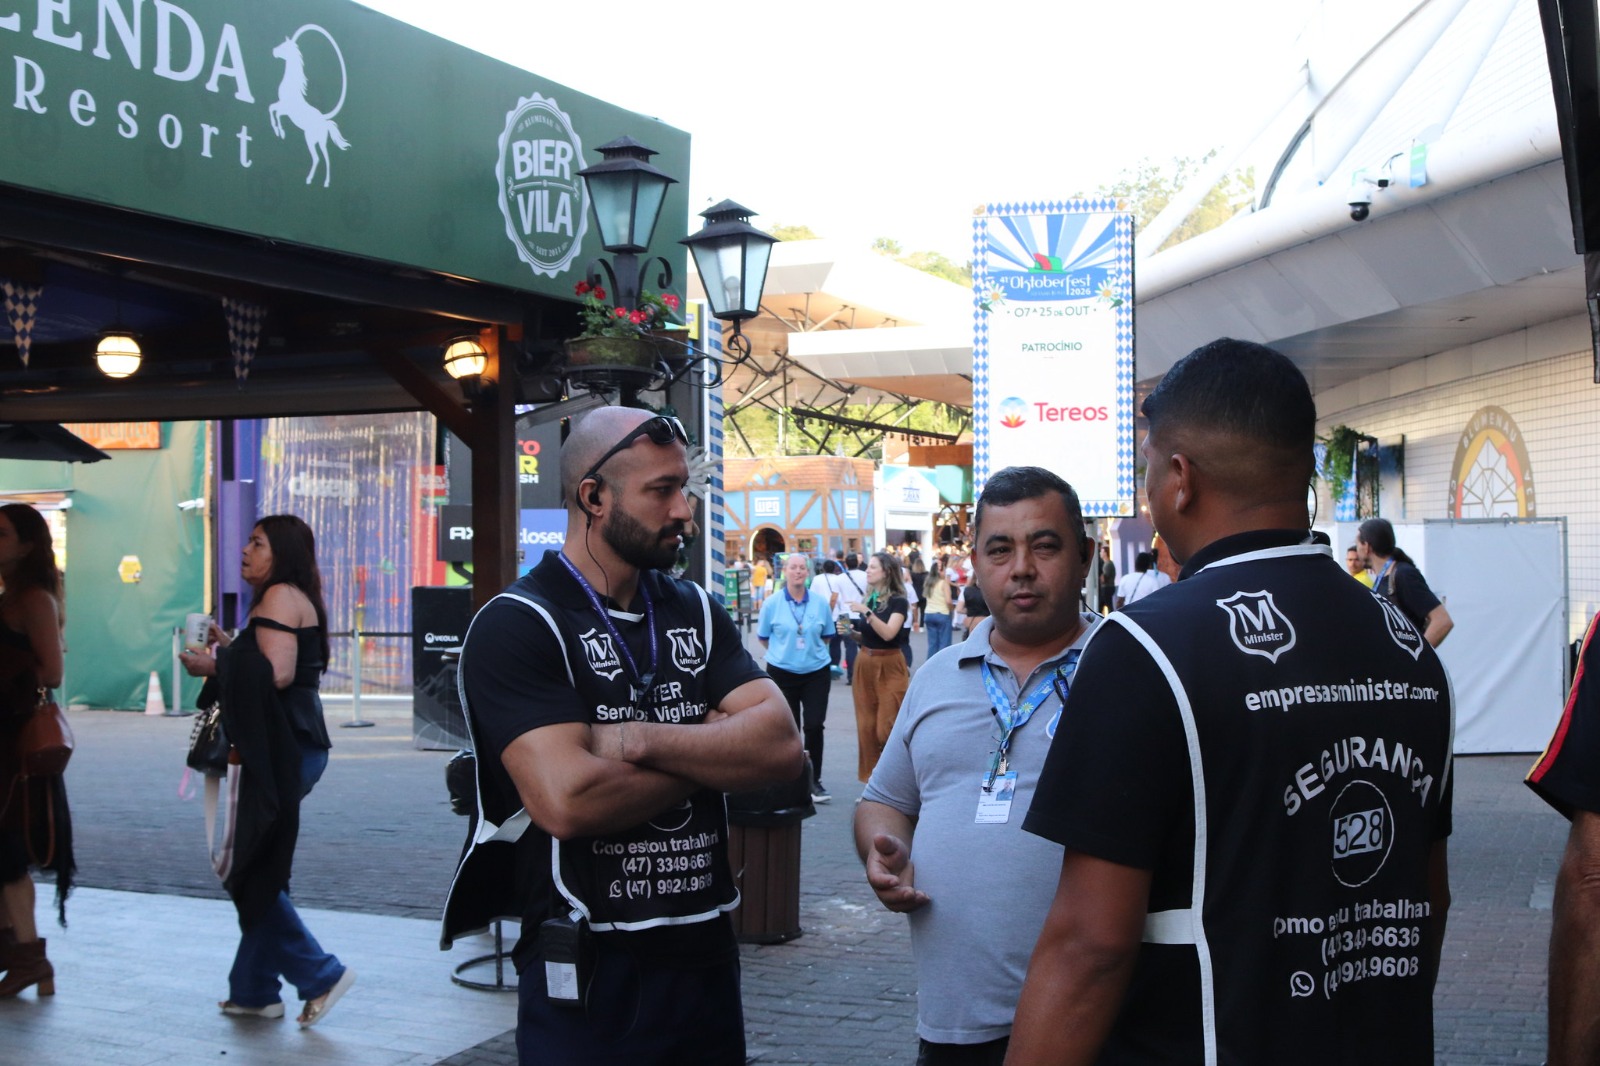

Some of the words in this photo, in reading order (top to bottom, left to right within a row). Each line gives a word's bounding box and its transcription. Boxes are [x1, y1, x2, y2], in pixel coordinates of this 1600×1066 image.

[0, 0, 255, 103] ENDA
[13, 55, 253, 168] Resort
[512, 139, 573, 180] BIER
[517, 189, 574, 237] VILA
[1010, 274, 1091, 296] Oktoberfest
[1070, 288, 1091, 296] 2026
[1014, 307, 1031, 317] 07
[1040, 307, 1052, 317] 25
[1065, 305, 1090, 316] OUT
[1021, 340, 1083, 352] PATROCÍNIO
[1034, 402, 1108, 423] Tereos
[1243, 632, 1284, 645] Minister
[1334, 810, 1383, 855] 528
[622, 856, 652, 876] (47)
[626, 879, 652, 899] (47)
[657, 873, 713, 894] 9924.968
